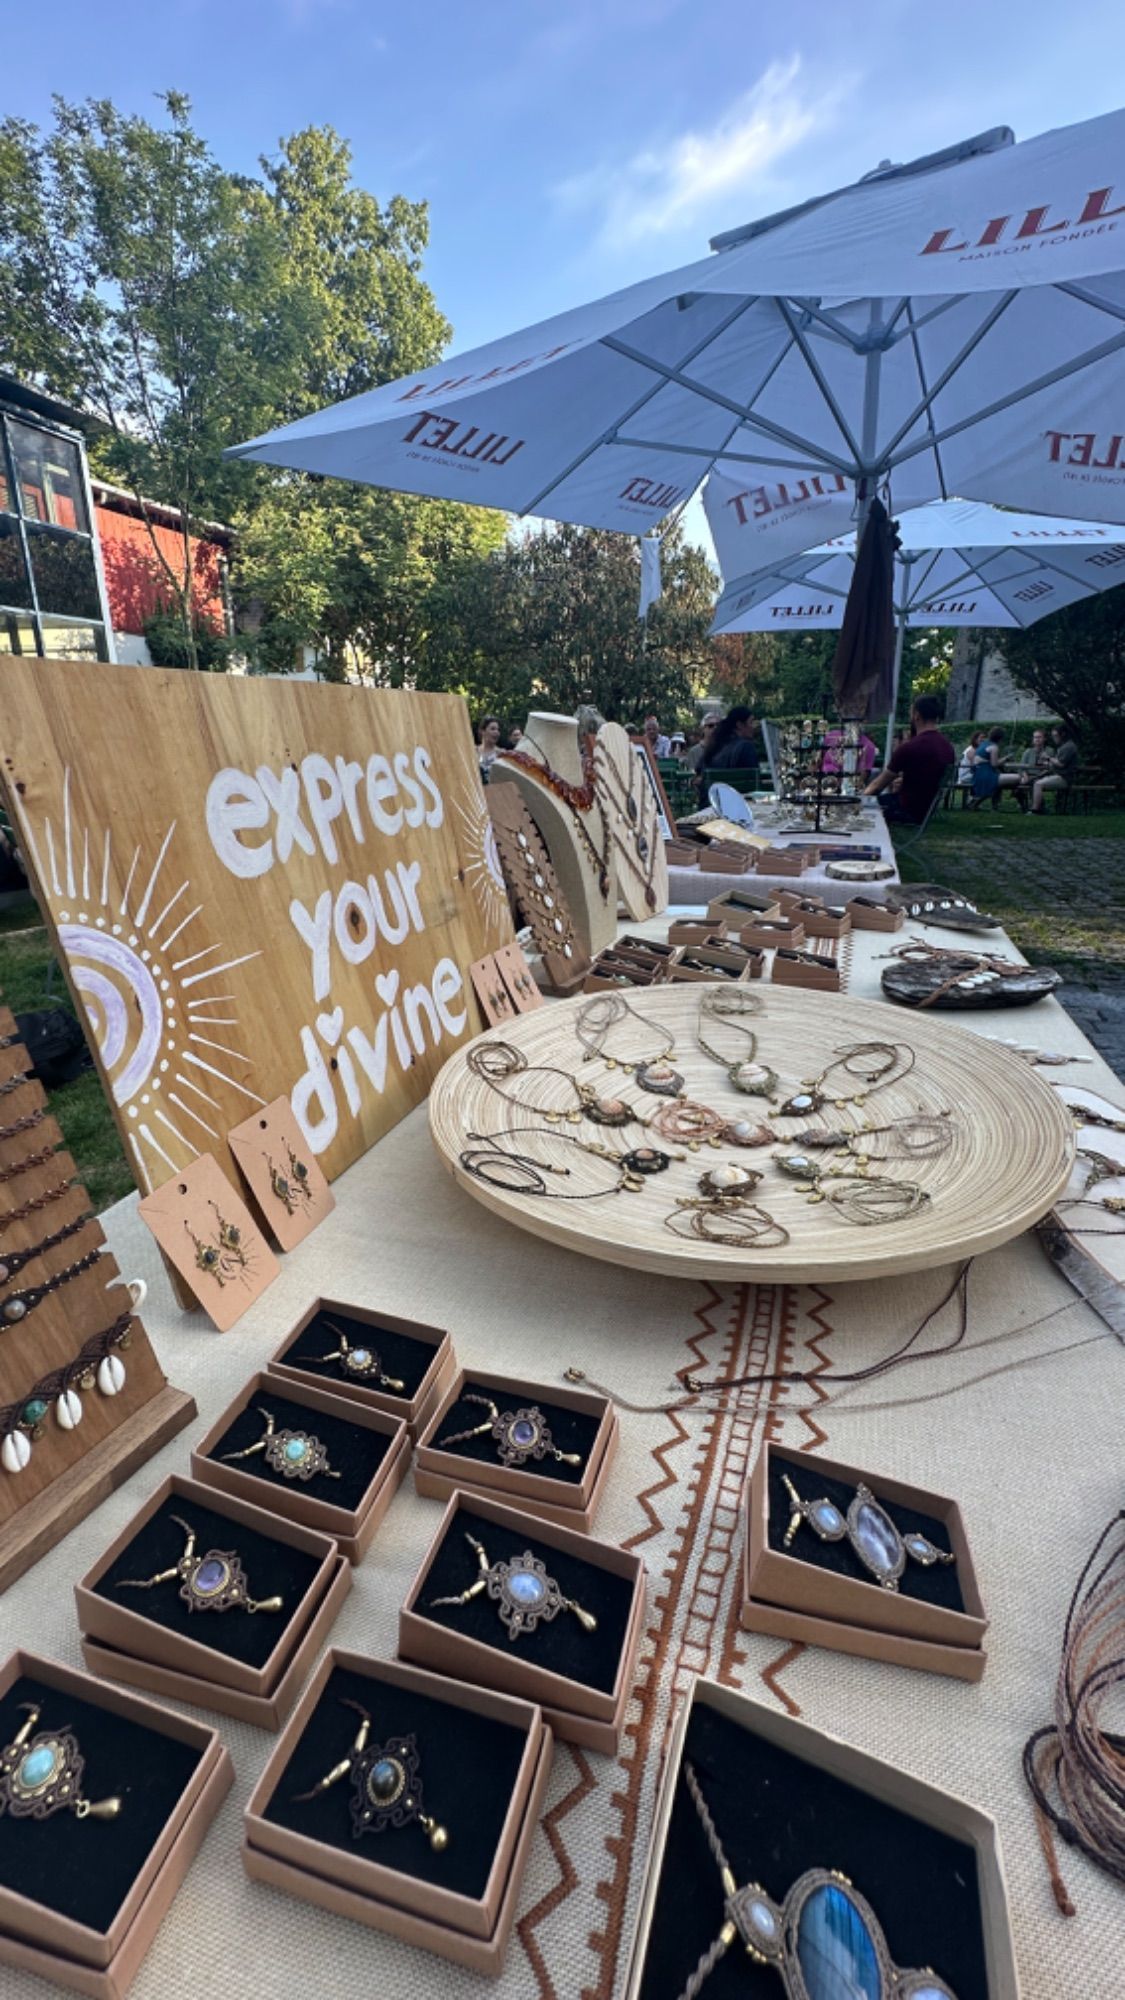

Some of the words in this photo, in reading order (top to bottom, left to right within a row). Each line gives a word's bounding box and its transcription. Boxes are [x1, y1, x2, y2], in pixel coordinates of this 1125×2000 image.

[958, 243, 1032, 263] MAISON
[205, 746, 444, 879] express
[289, 860, 422, 1003] your
[290, 957, 468, 1155] divine
